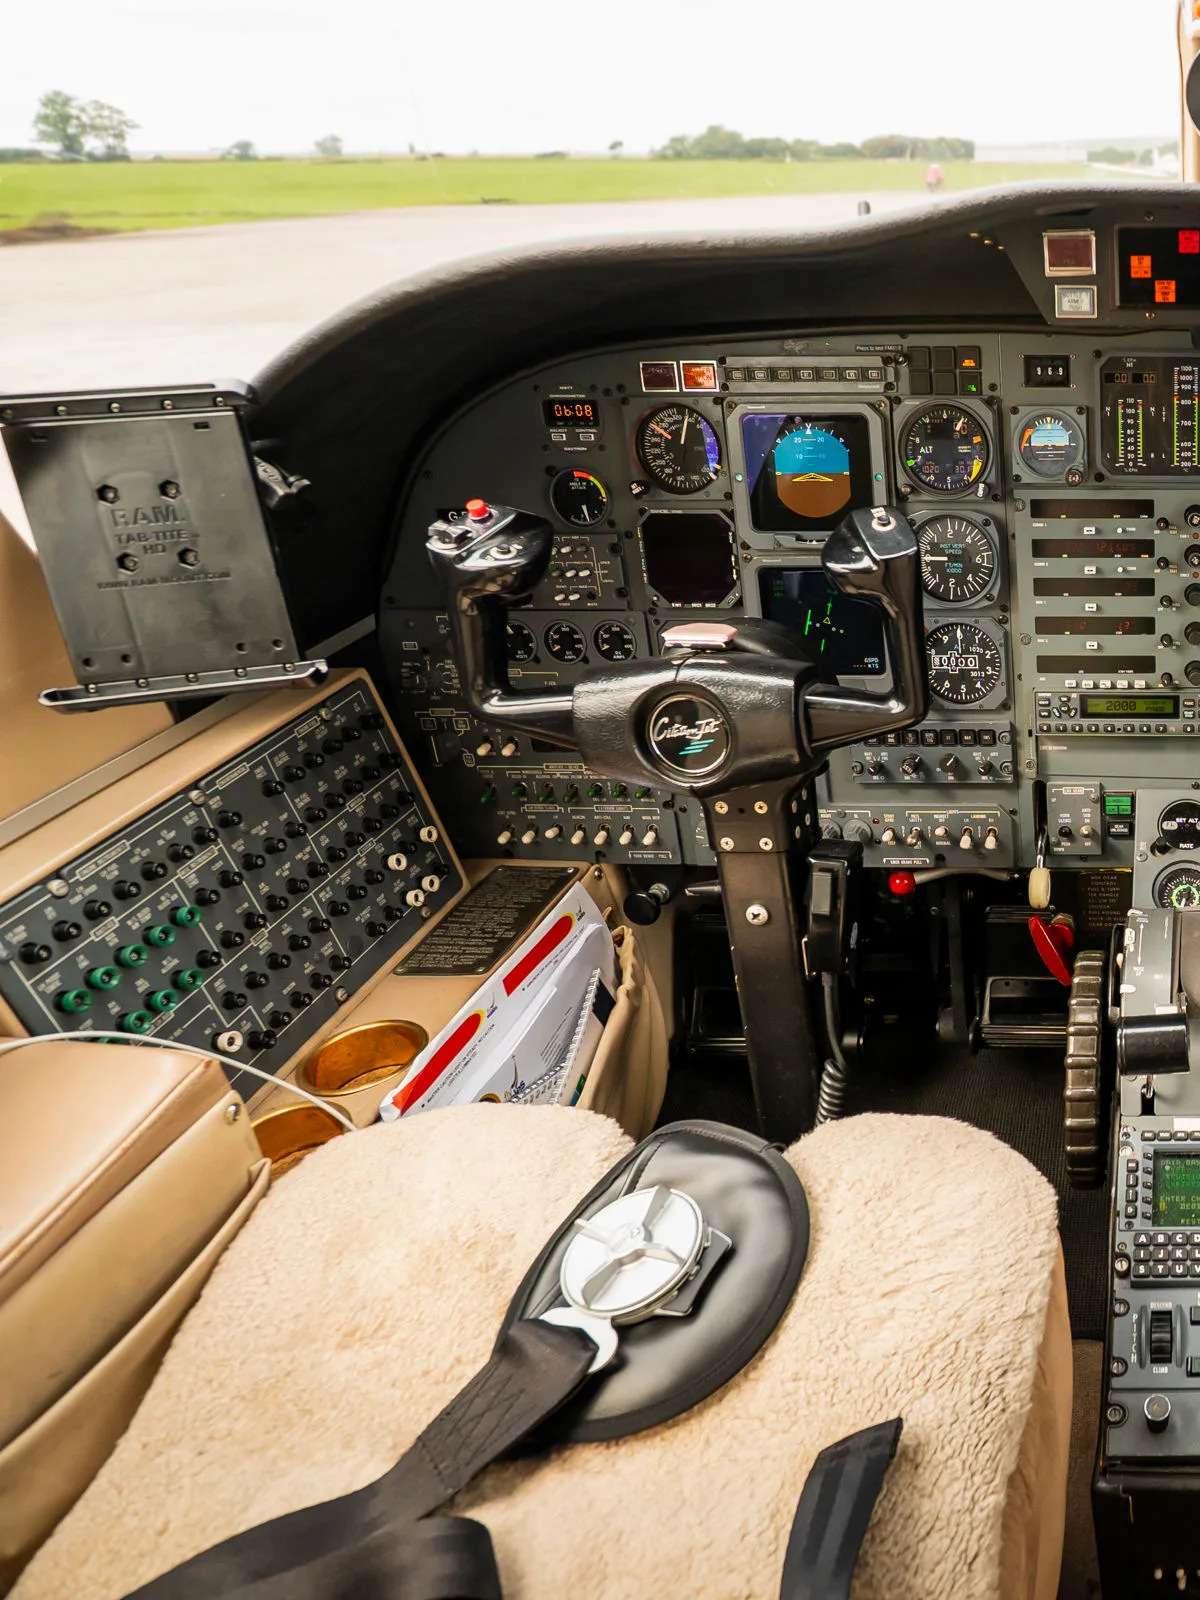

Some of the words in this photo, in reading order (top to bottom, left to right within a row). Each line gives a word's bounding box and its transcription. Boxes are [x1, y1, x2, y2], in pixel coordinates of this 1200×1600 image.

[947, 530, 953, 538] 2
[966, 536, 971, 544] 4
[143, 543, 166, 555] HD
[976, 555, 981, 563] 6
[949, 578, 955, 587] 2
[1106, 701, 1136, 711] 2000
[1139, 1234, 1147, 1242] A
[1139, 1265, 1145, 1273] S
[1176, 1265, 1182, 1273] U
